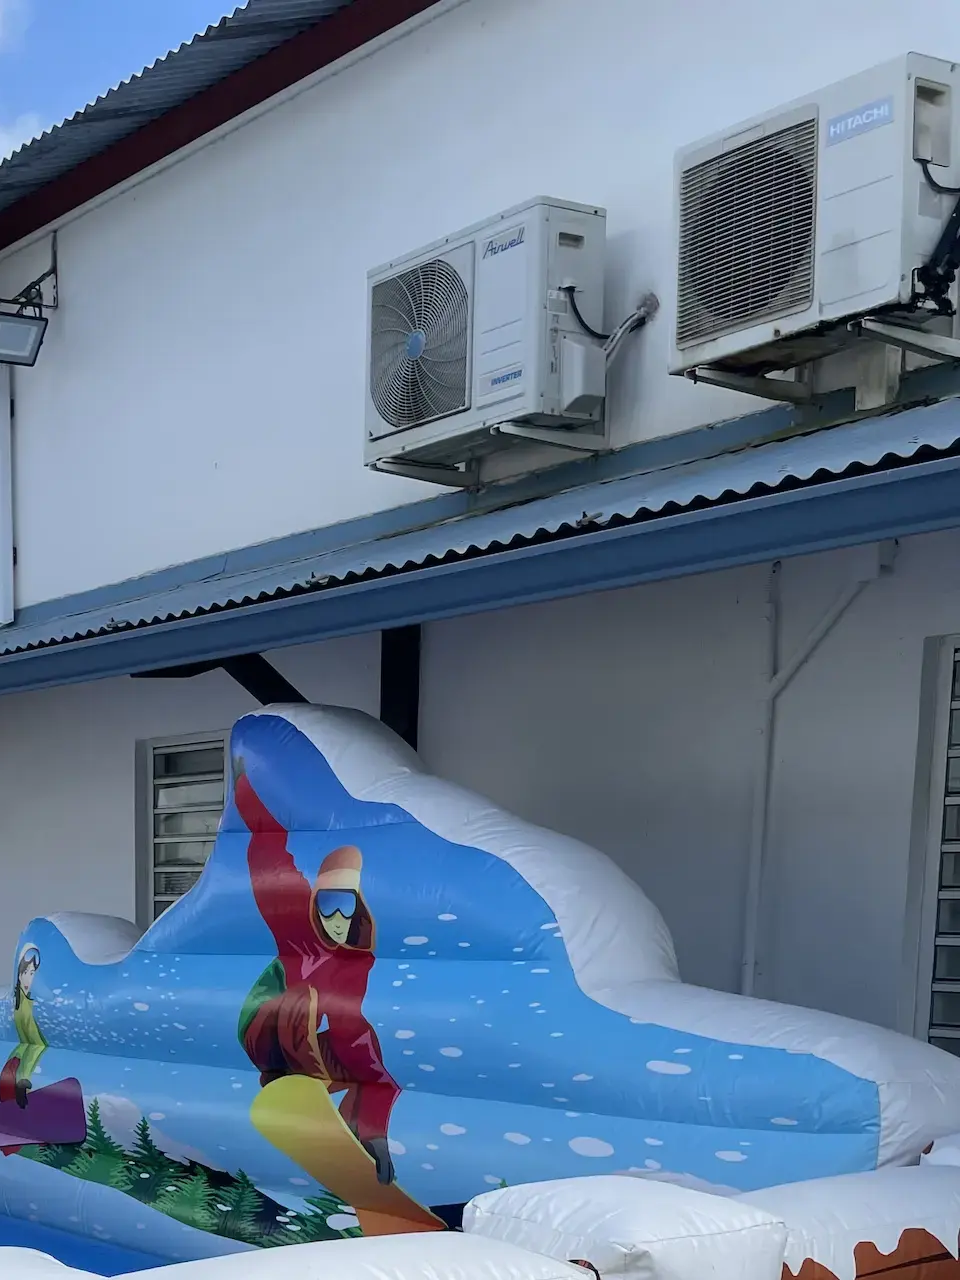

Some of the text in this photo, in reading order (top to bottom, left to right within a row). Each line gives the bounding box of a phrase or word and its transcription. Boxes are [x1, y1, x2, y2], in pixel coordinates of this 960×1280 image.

[829, 103, 890, 138] HITACHI
[482, 226, 524, 260] Airwell
[491, 370, 523, 386] INVERTER
